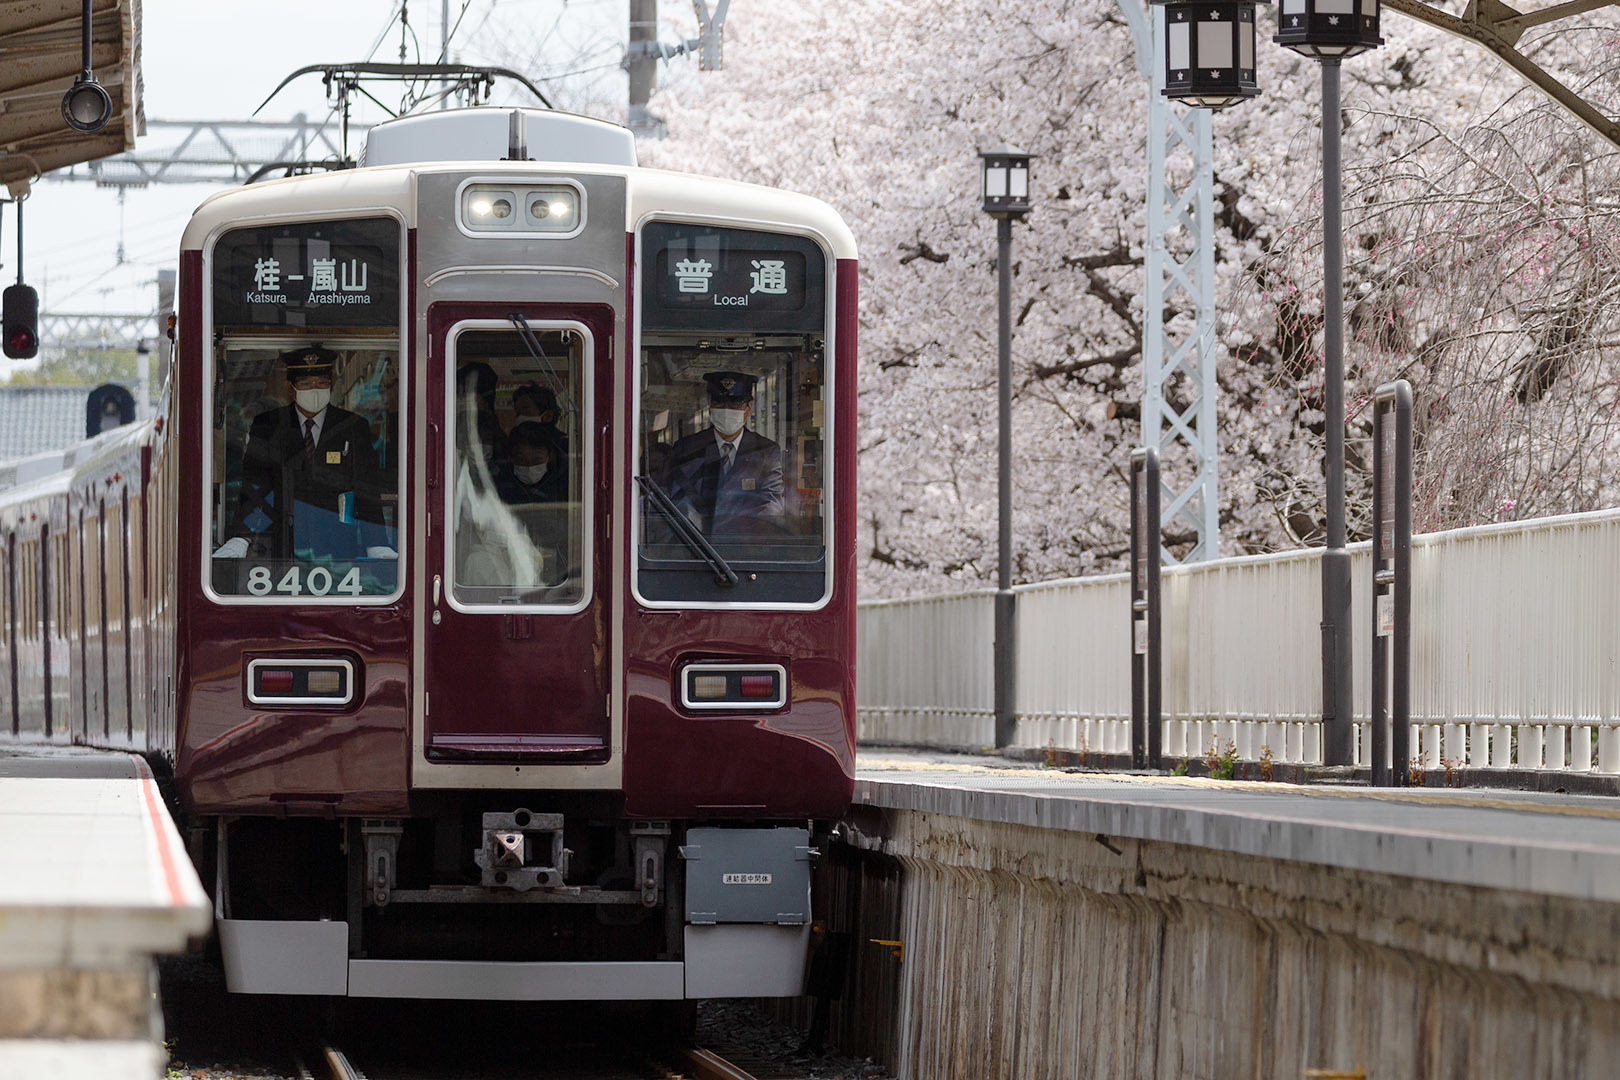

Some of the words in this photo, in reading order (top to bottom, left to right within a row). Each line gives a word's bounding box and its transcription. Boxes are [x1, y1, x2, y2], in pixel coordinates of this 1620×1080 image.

[674, 258, 788, 294] 普通
[246, 292, 287, 304] Katsura
[307, 292, 371, 306] Arashiyama
[713, 294, 749, 306] Local
[247, 566, 363, 597] 8404
